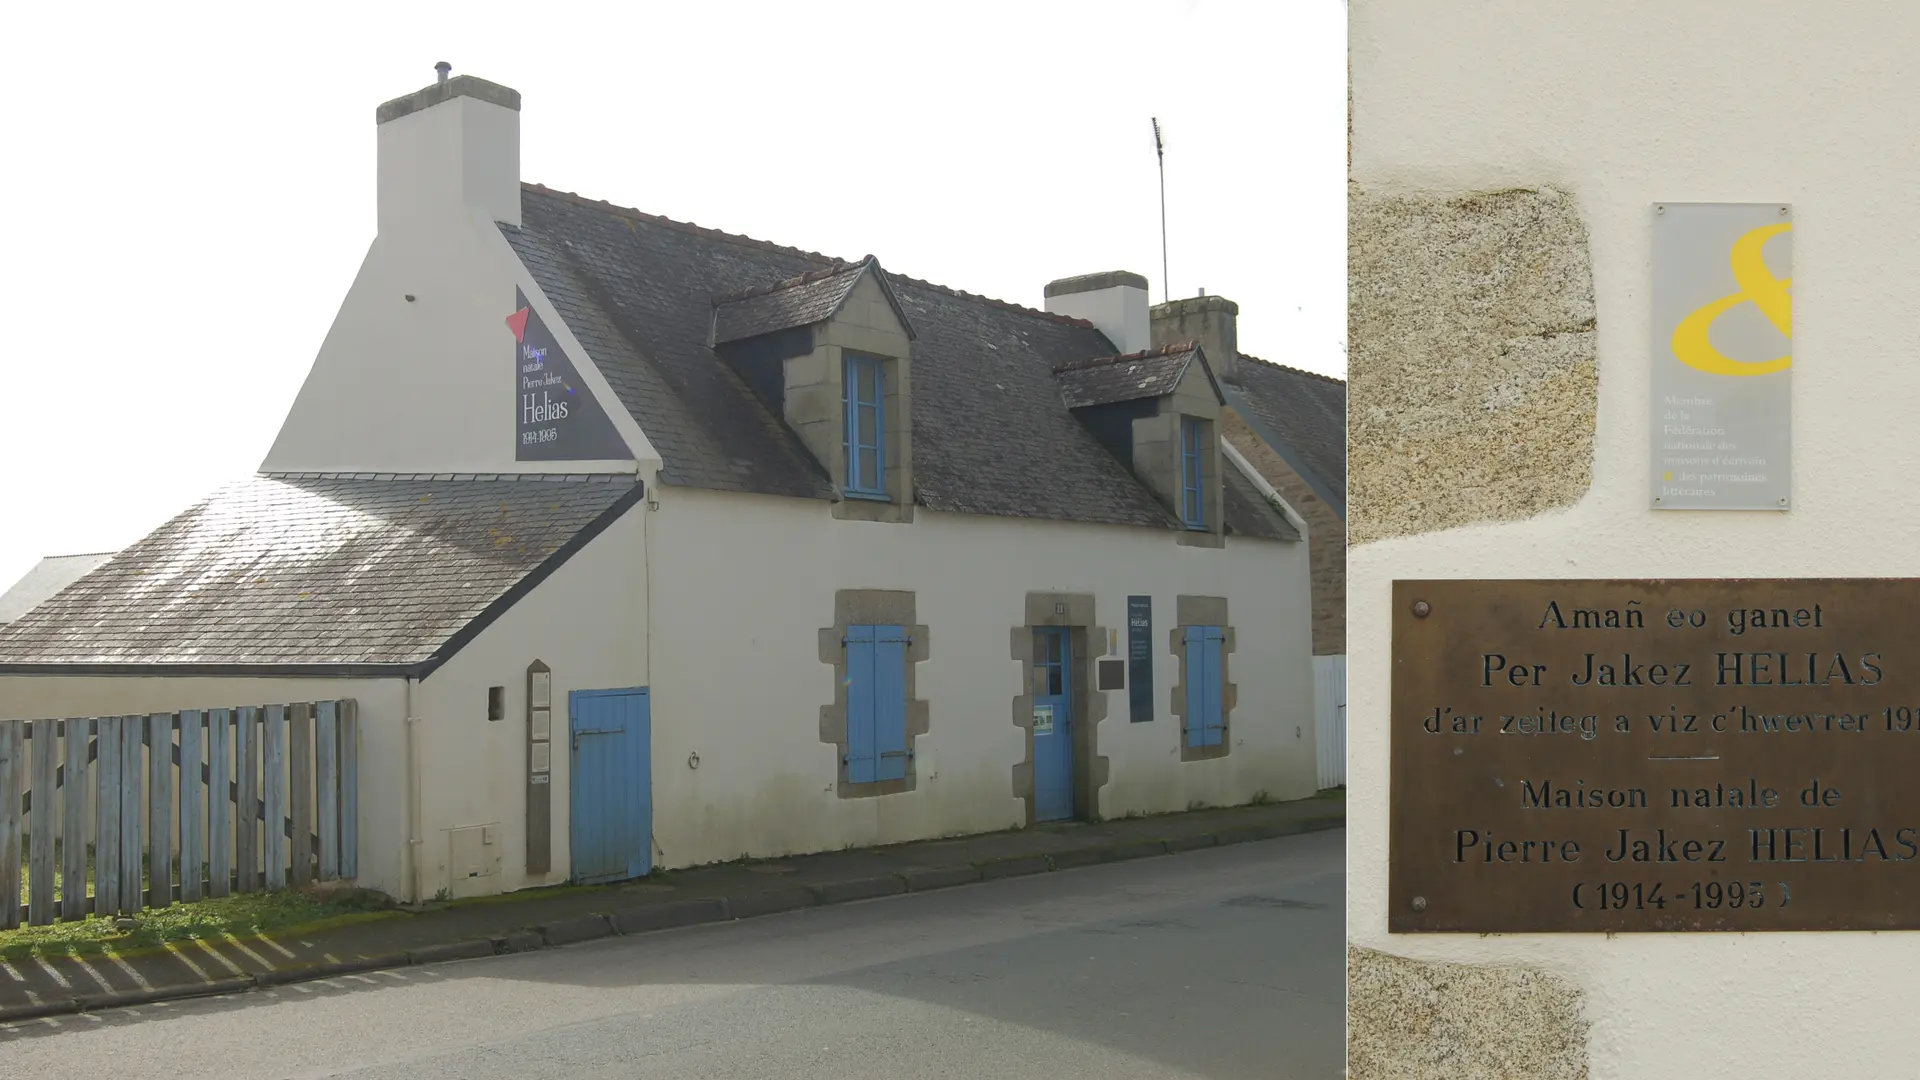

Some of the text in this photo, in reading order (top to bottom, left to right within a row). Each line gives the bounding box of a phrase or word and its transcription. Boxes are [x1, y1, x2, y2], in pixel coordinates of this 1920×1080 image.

[523, 345, 547, 360] Maison
[523, 358, 544, 373] natale
[523, 391, 568, 424] Helias
[1664, 396, 1713, 405] Membre
[1663, 410, 1690, 421] de la
[522, 428, 557, 444] 1914-1995
[1664, 424, 1725, 436] Fédération
[1664, 440, 1737, 450] nationale des
[1664, 456, 1709, 466] maisons
[1679, 471, 1697, 481] des
[1700, 472, 1767, 485] patrimoines
[1663, 486, 1716, 497] littéraires
[1538, 600, 1823, 636] Amañ eo ganet
[1481, 652, 1884, 688] Per Jakez HELIAS
[1423, 708, 1483, 735] d'ar
[1500, 707, 1598, 741] zeiteg
[1614, 712, 1631, 734] a
[1648, 706, 1698, 734] viz
[1711, 705, 1868, 735] c'hwevrer
[1521, 777, 1843, 810] Maison natale de
[1453, 828, 1920, 864] Pierre Jakez HELIAS
